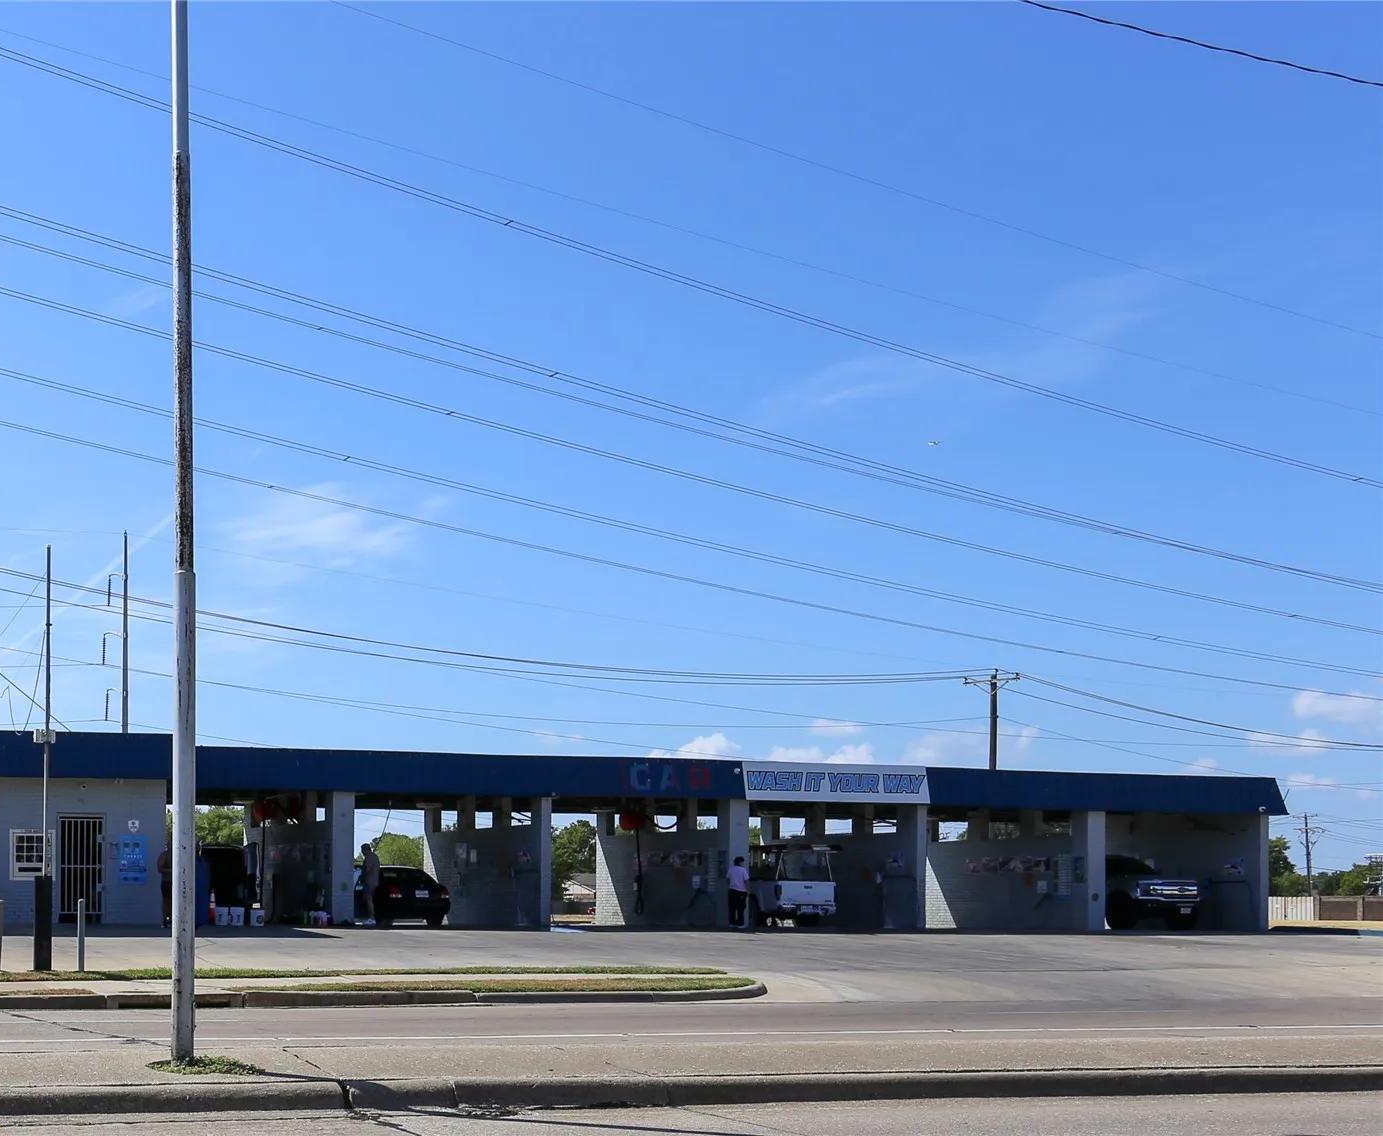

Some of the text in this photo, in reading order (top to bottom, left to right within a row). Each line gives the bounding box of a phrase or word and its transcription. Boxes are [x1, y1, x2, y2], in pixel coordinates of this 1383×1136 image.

[746, 770, 926, 794] WASH IT YOUR WAY
